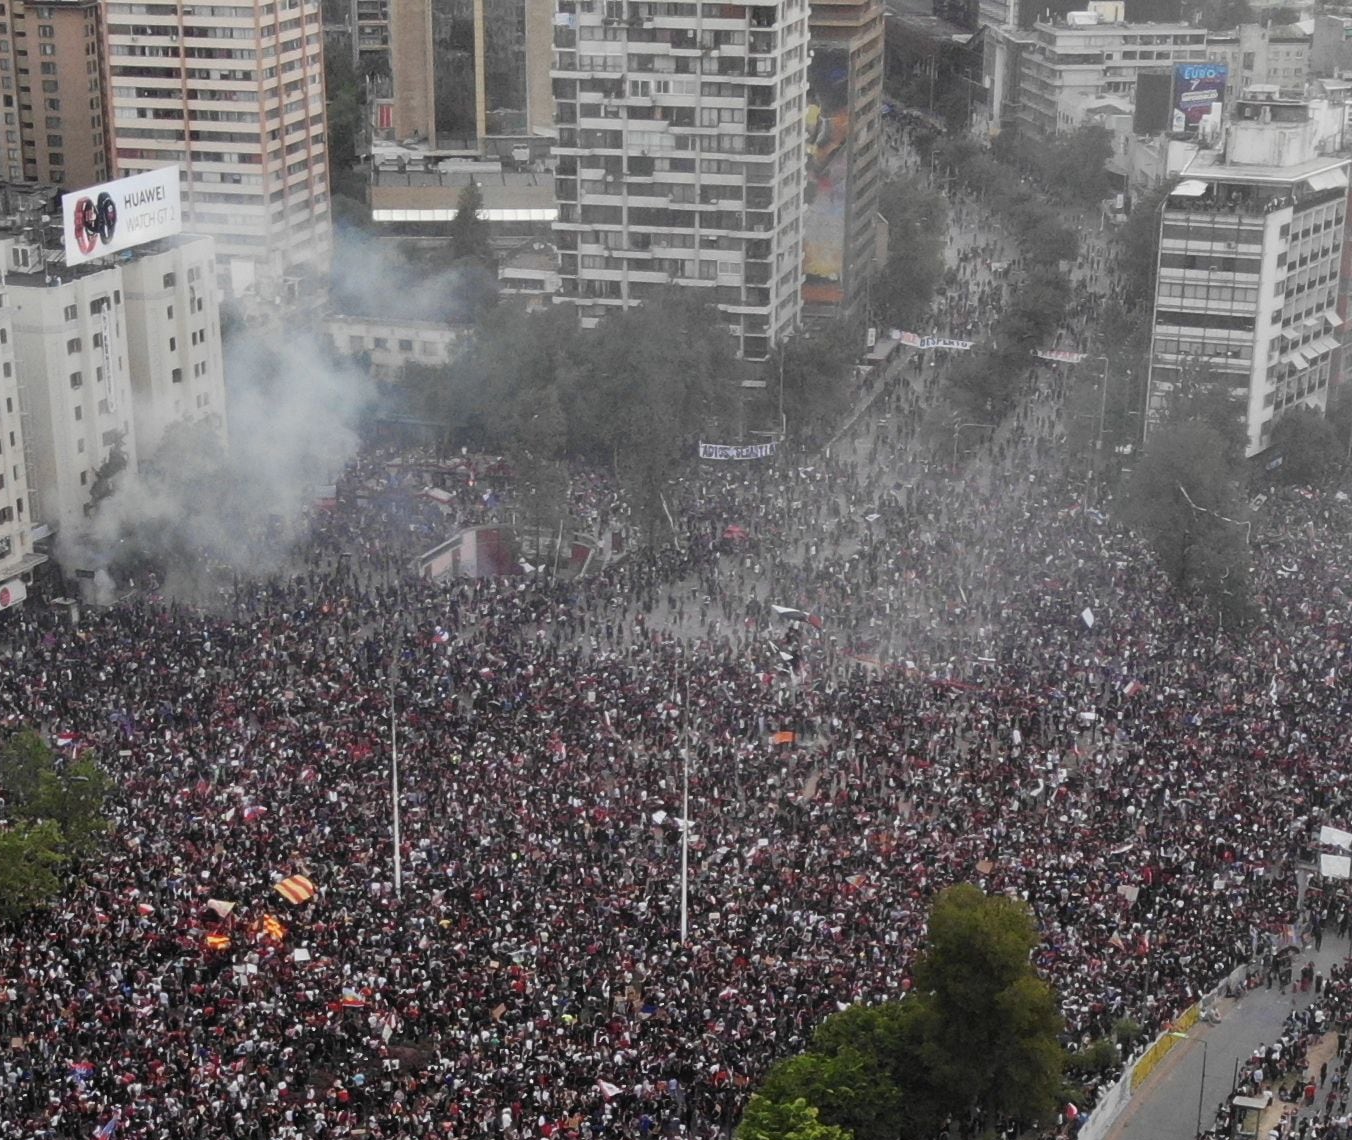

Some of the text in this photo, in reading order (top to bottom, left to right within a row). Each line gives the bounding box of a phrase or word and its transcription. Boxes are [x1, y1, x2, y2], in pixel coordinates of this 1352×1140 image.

[124, 185, 166, 209] HUAWEI
[127, 212, 155, 233] WATCH
[156, 207, 168, 224] GT
